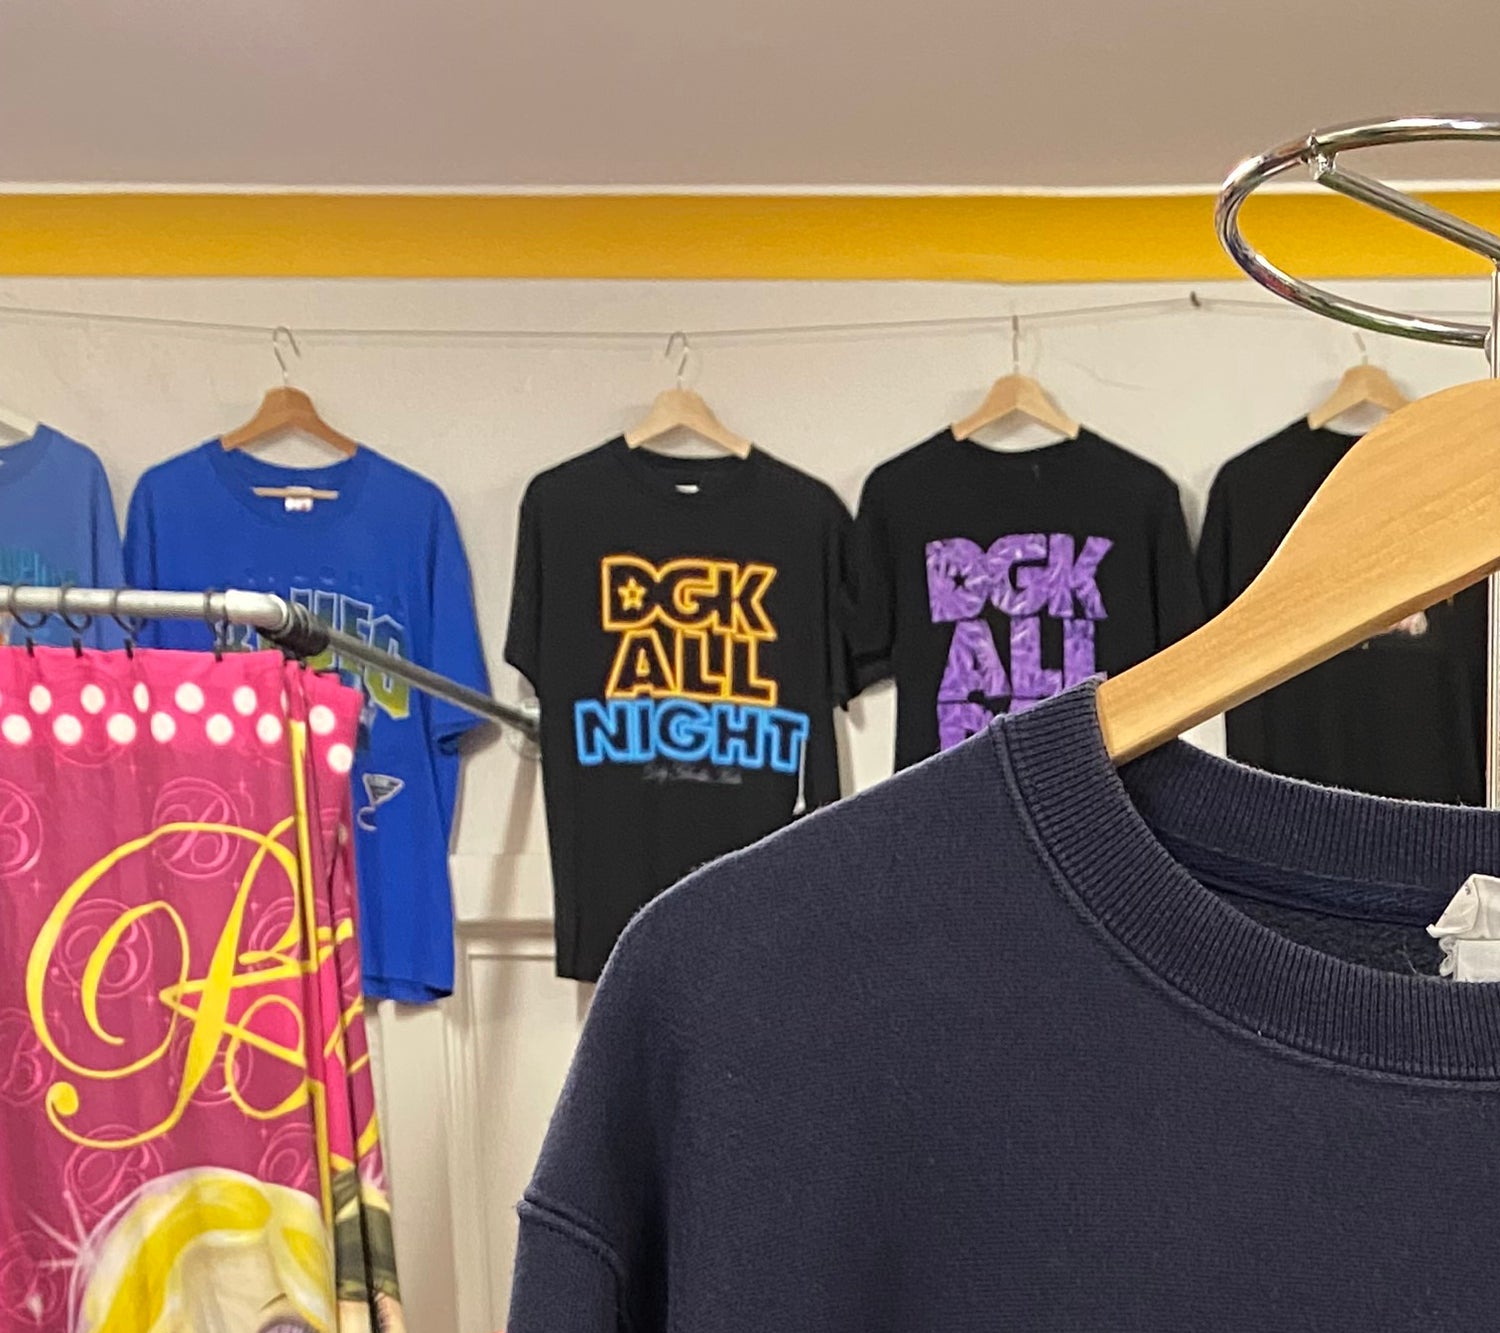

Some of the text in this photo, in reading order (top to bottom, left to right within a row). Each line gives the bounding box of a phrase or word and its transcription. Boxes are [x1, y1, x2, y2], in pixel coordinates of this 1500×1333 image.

[601, 553, 778, 642] DGK
[924, 532, 1114, 624] DGK
[606, 626, 778, 708] ALL
[937, 614, 1108, 702] ALL
[574, 699, 810, 775] NIGHT
